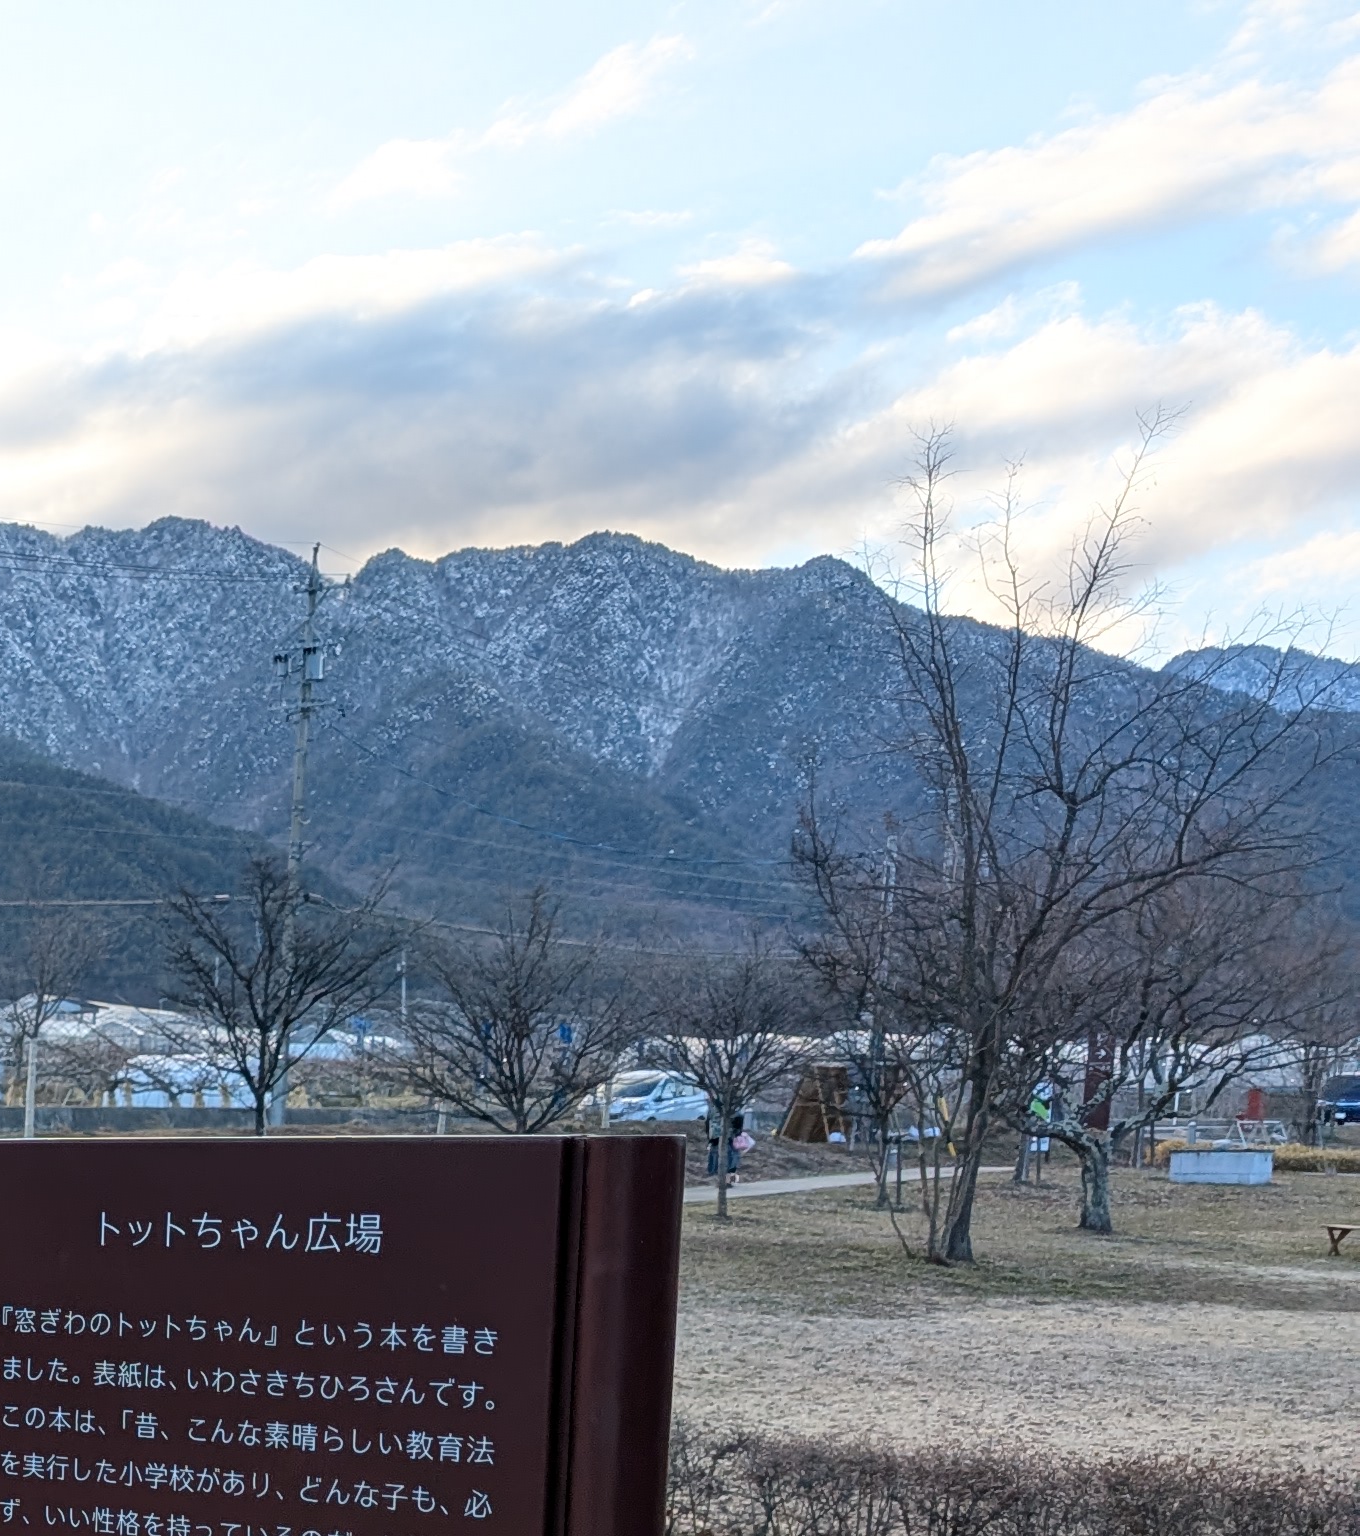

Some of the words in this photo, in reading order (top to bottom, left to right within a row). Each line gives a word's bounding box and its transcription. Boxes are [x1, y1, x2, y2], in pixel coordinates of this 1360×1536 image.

[100, 1211, 384, 1254] トットちゃん広場
[1, 1305, 498, 1355] 『窓ぎわのトットちゃん』という本を書き
[2, 1355, 495, 1411] ました。表紙は、いわさきちひろさんです。
[2, 1405, 495, 1465] この本は、「昔、こんな素晴らしい教育法
[0, 1450, 493, 1518] を実行した小学校があり、どんな子も、必
